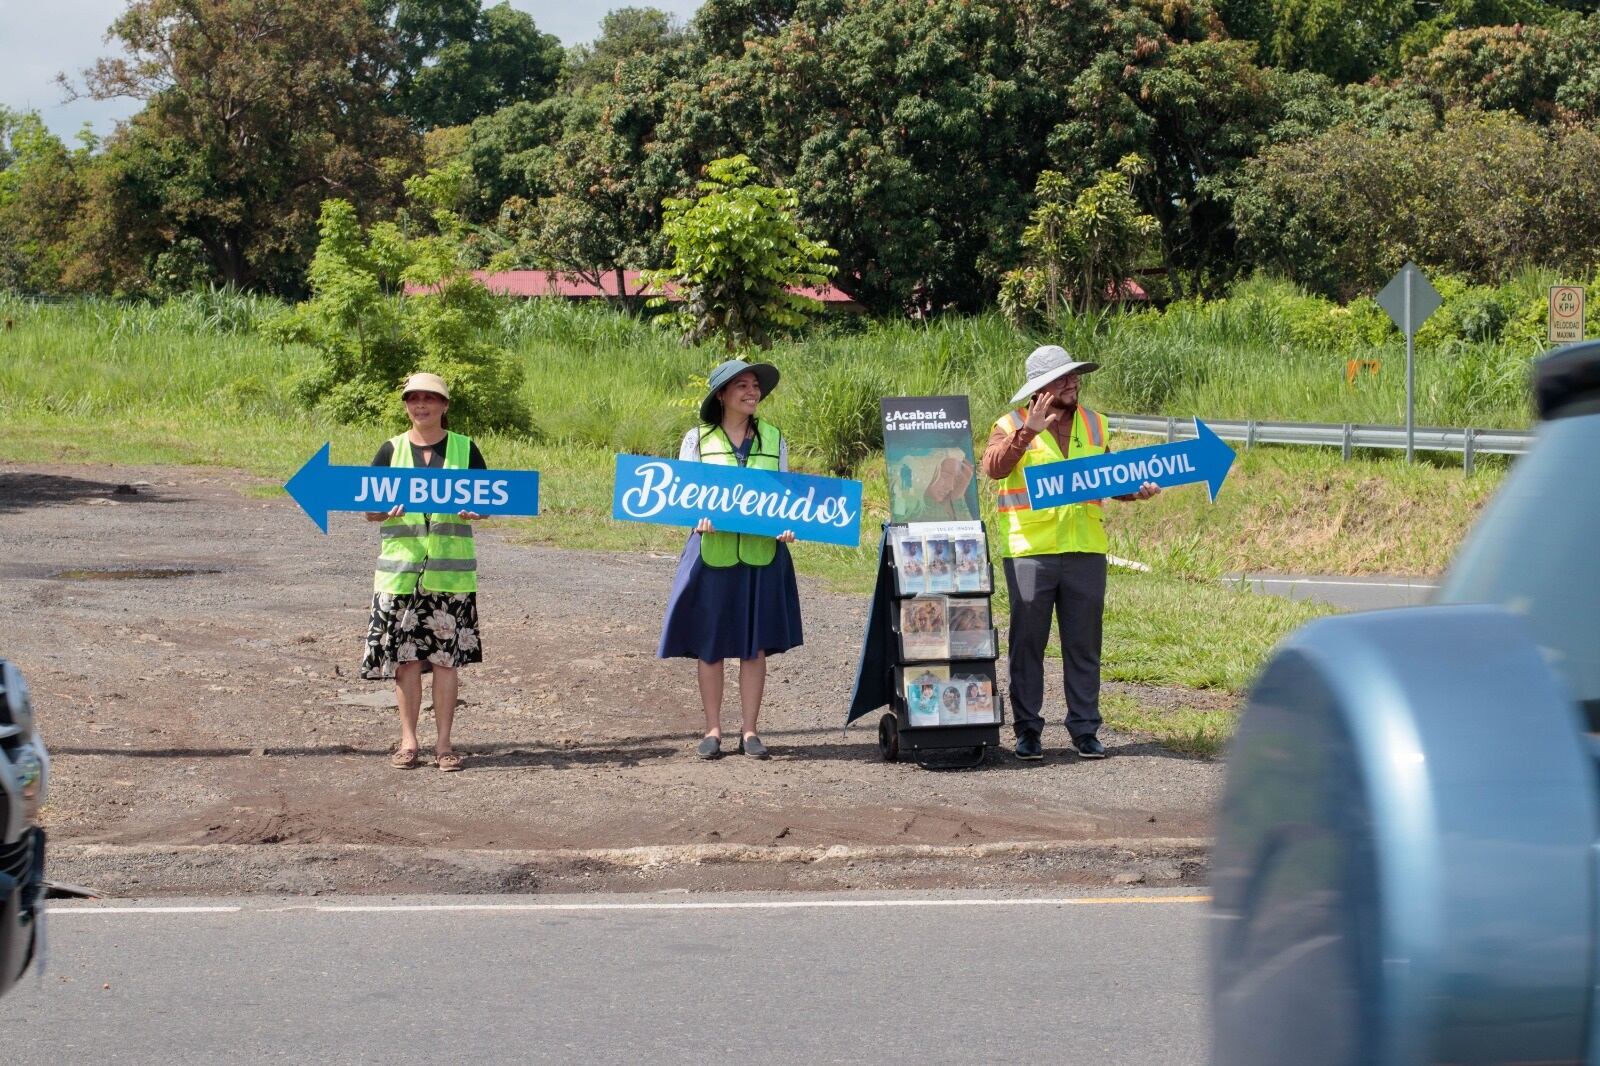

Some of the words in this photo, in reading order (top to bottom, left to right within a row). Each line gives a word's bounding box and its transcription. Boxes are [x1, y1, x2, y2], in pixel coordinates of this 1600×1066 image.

[1561, 293, 1572, 301] 20
[1559, 303, 1575, 312] KPH
[1553, 321, 1579, 329] VELOCIDAD
[885, 409, 947, 422] ¿Acabará
[885, 421, 897, 431] el
[898, 420, 968, 431] sufrimiento?
[1034, 474, 1065, 499] JW
[1071, 453, 1196, 493] AUTOMÓVIL
[354, 476, 401, 503] JW
[409, 477, 509, 506] BUSES
[621, 461, 857, 528] Bienvenidos
